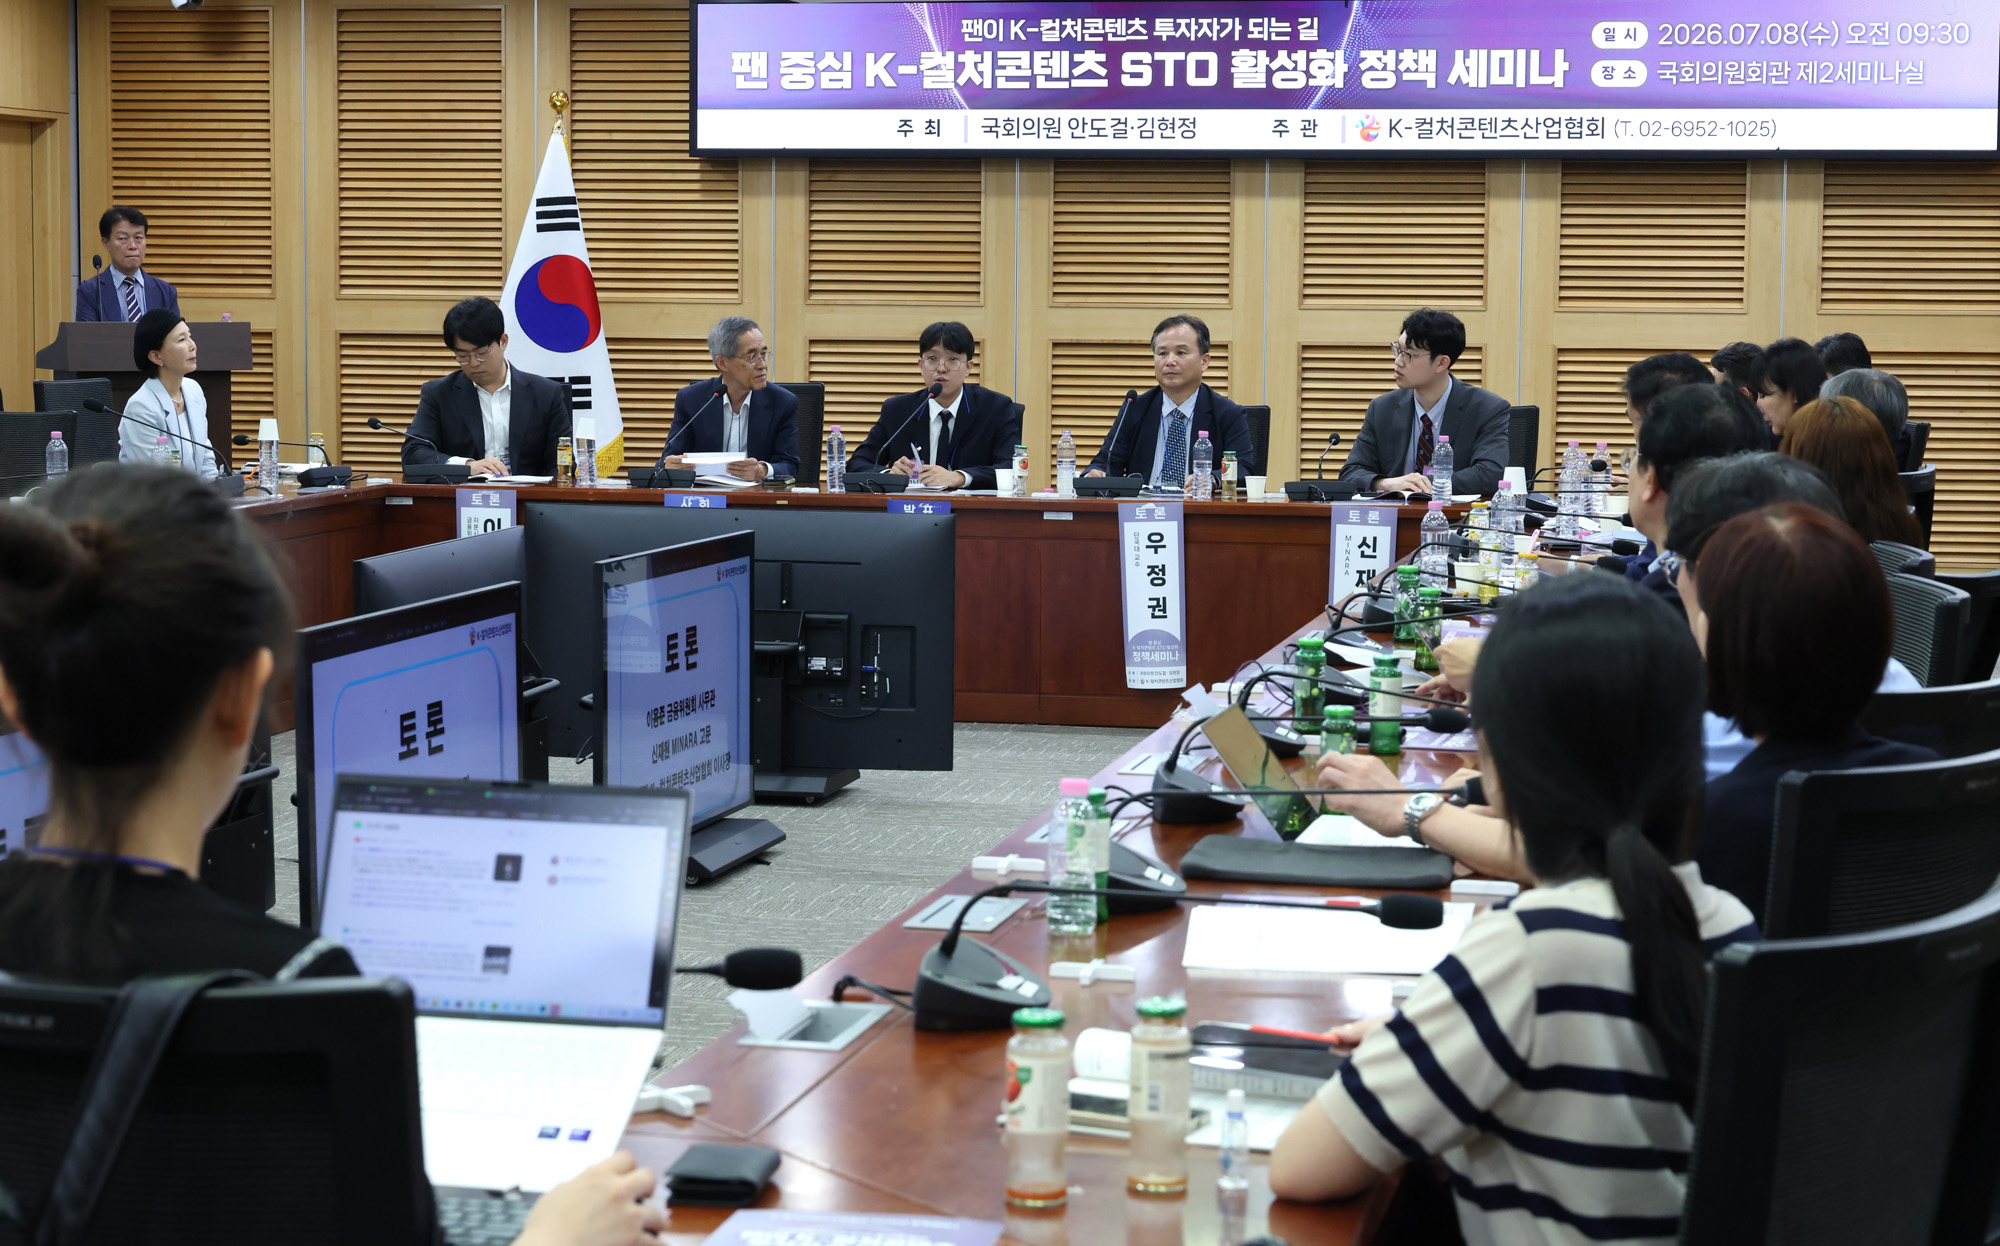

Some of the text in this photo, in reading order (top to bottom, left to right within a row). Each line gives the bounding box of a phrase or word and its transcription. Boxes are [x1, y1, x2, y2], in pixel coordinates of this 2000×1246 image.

[961, 17, 1319, 42] 팬이 K-컬처콘텐츠 투자자가 되는 길
[1657, 21, 1970, 47] 2026.07.08(수) 오전 09:30
[731, 48, 1570, 89] 팬 중심 K-컬처콘텐츠 STO 활성화 정책 세미나
[1656, 60, 1925, 86] 국회의원회관 제2세미나실
[981, 117, 1197, 140] 국회의원 안도걸·김현정
[1388, 116, 1777, 140] K-컬처콘텐츠산업협회 (T. 02-6952-1025)
[1344, 535, 1352, 576] MINARA
[1145, 532, 1168, 619] 우정권
[665, 625, 699, 673] 토론
[1132, 650, 1180, 662] 정책세미나
[667, 694, 697, 723] 금융위원회
[698, 688, 716, 711] 사무관
[398, 700, 445, 761] 토론
[671, 730, 698, 756] MINARA
[699, 725, 712, 745] 고문
